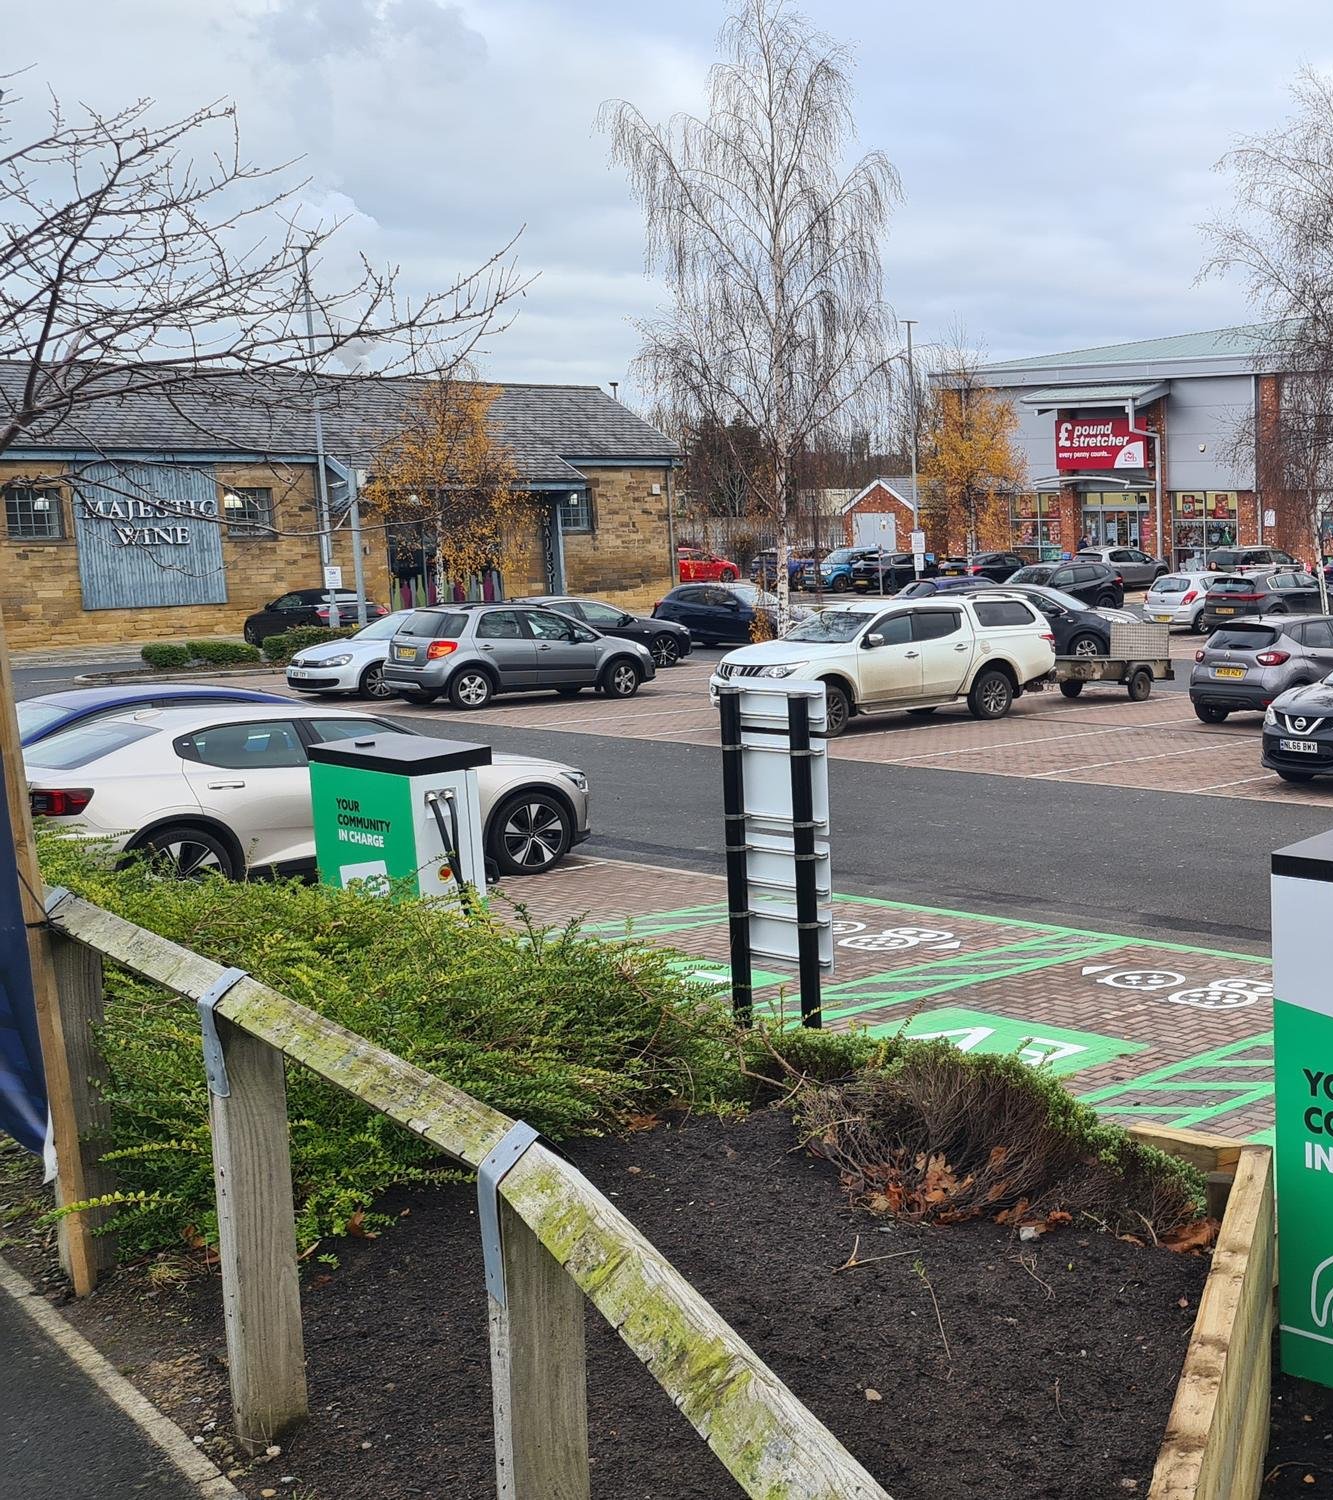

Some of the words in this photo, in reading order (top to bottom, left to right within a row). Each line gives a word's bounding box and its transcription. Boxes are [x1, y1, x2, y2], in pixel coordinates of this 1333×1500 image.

[1073, 421, 1113, 437] pound
[1072, 434, 1129, 447] stretcher
[1058, 451, 1073, 460] every
[1073, 451, 1090, 460] penny
[83, 499, 217, 521] MAJESTIC
[114, 526, 191, 545] WINE
[336, 798, 360, 812] YOUR
[337, 813, 391, 833] COMMUNITY
[338, 828, 348, 841] IN
[349, 831, 385, 848] CHARGE
